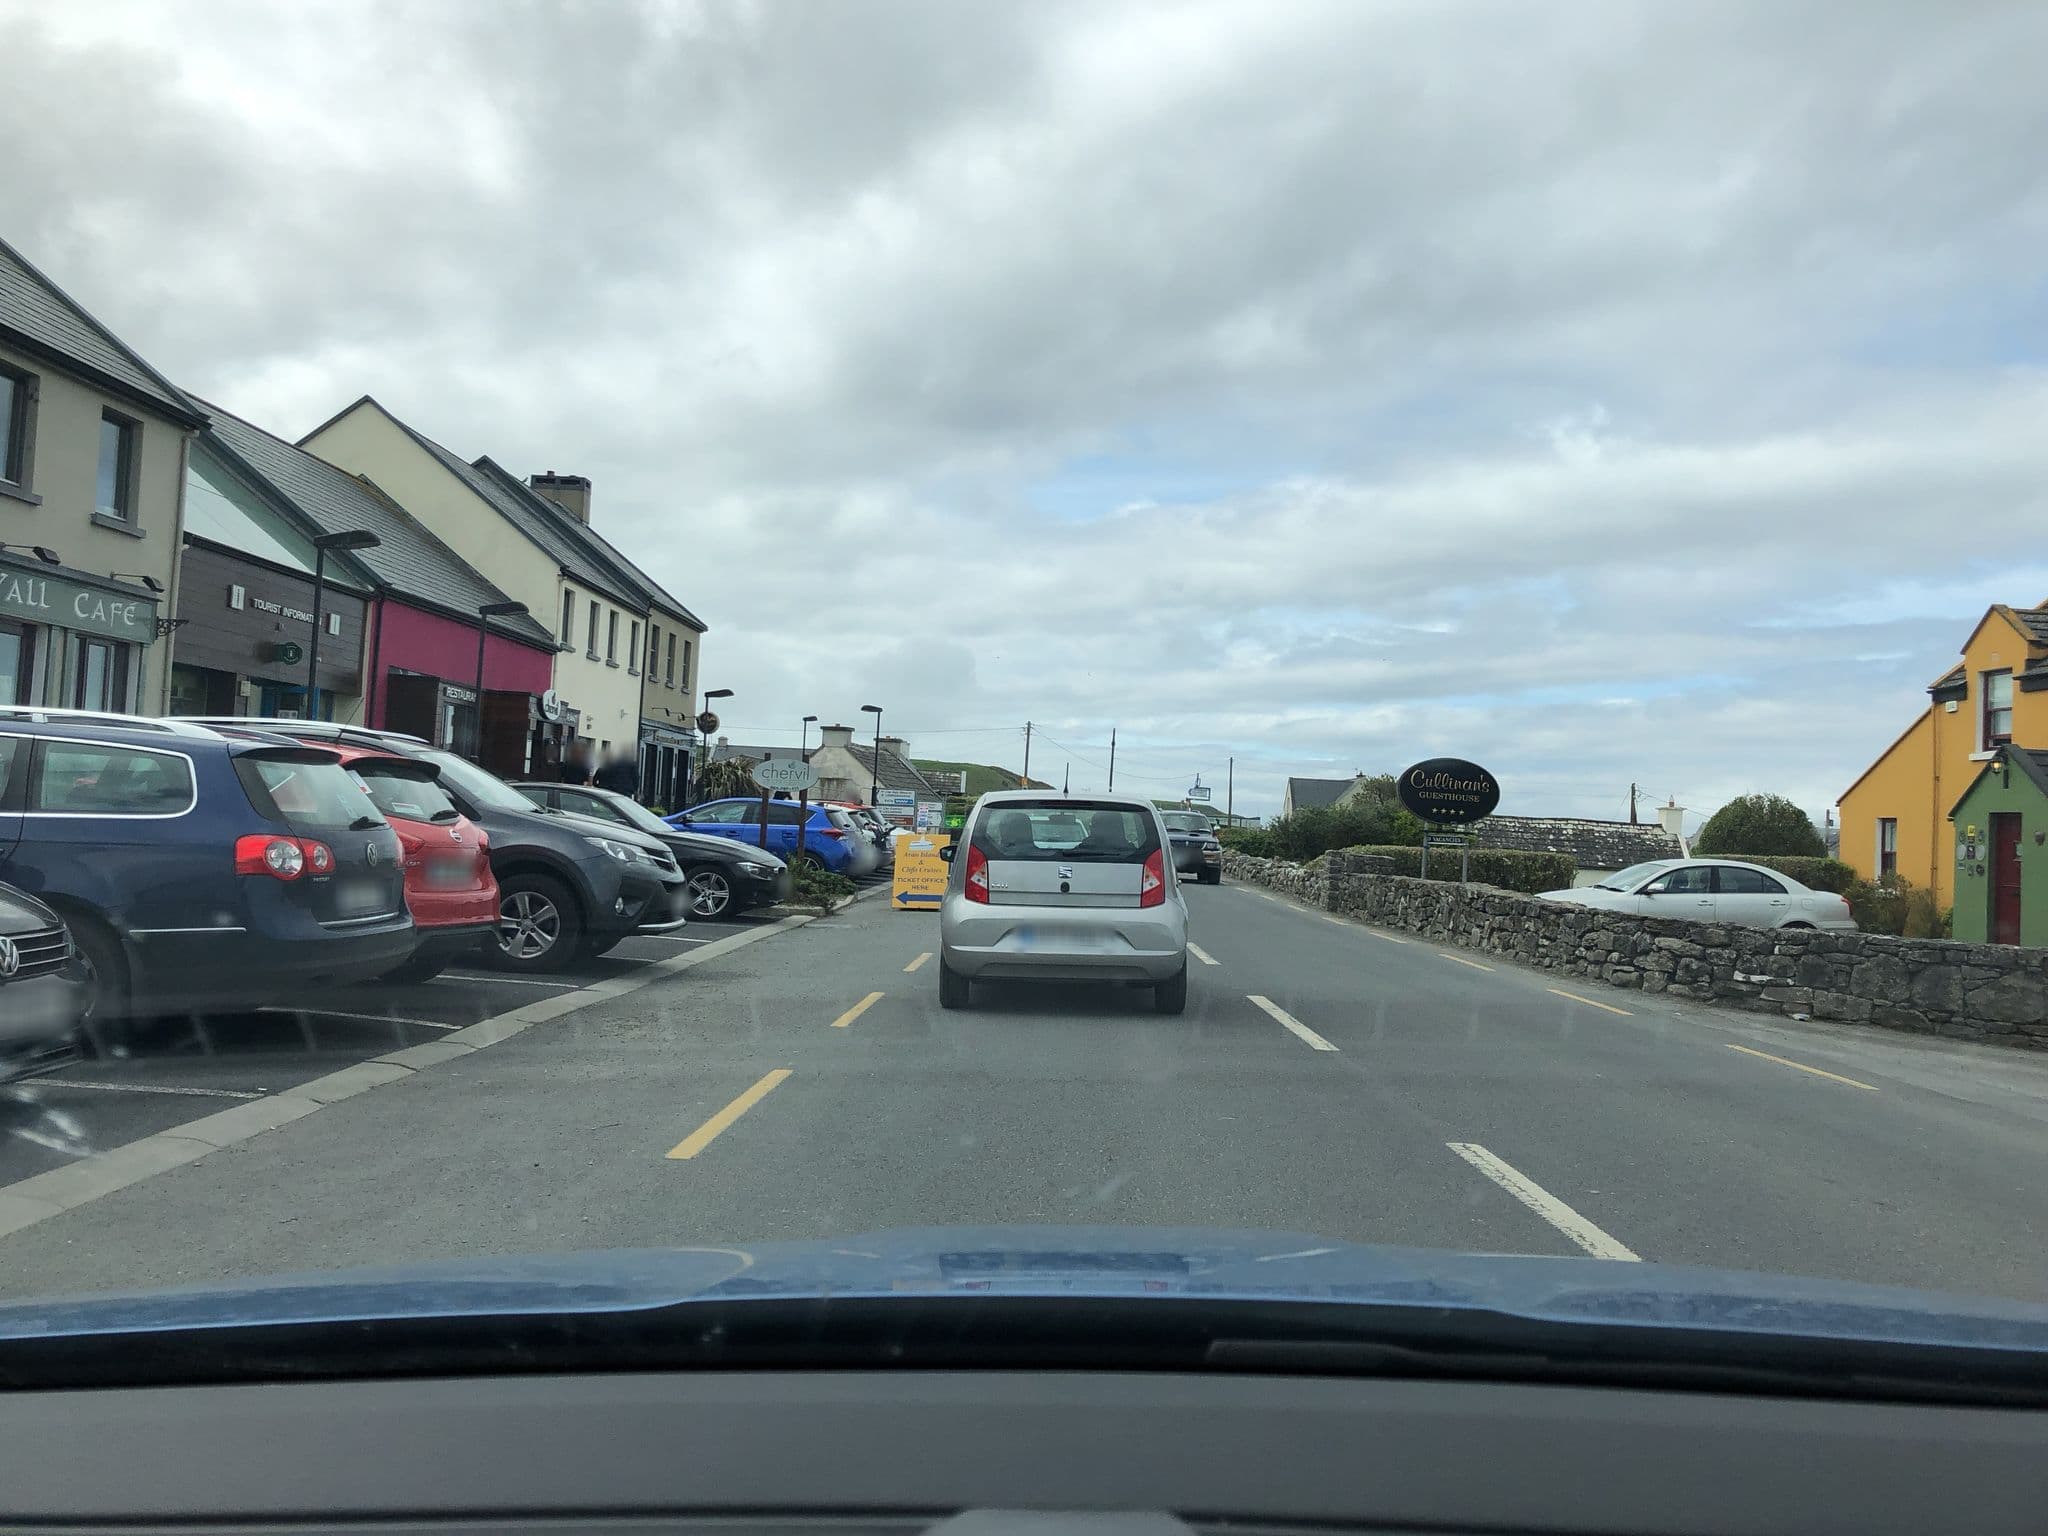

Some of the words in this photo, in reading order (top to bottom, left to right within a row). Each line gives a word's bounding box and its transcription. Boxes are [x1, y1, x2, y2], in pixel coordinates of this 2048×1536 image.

[254, 598, 281, 615] TOURIST
[282, 609, 322, 625] INFORMATI
[446, 686, 477, 702] RESTAURA
[761, 763, 810, 781] chervil
[1410, 769, 1490, 793] Cullinan's
[1419, 791, 1480, 803] GUESTHOUSE
